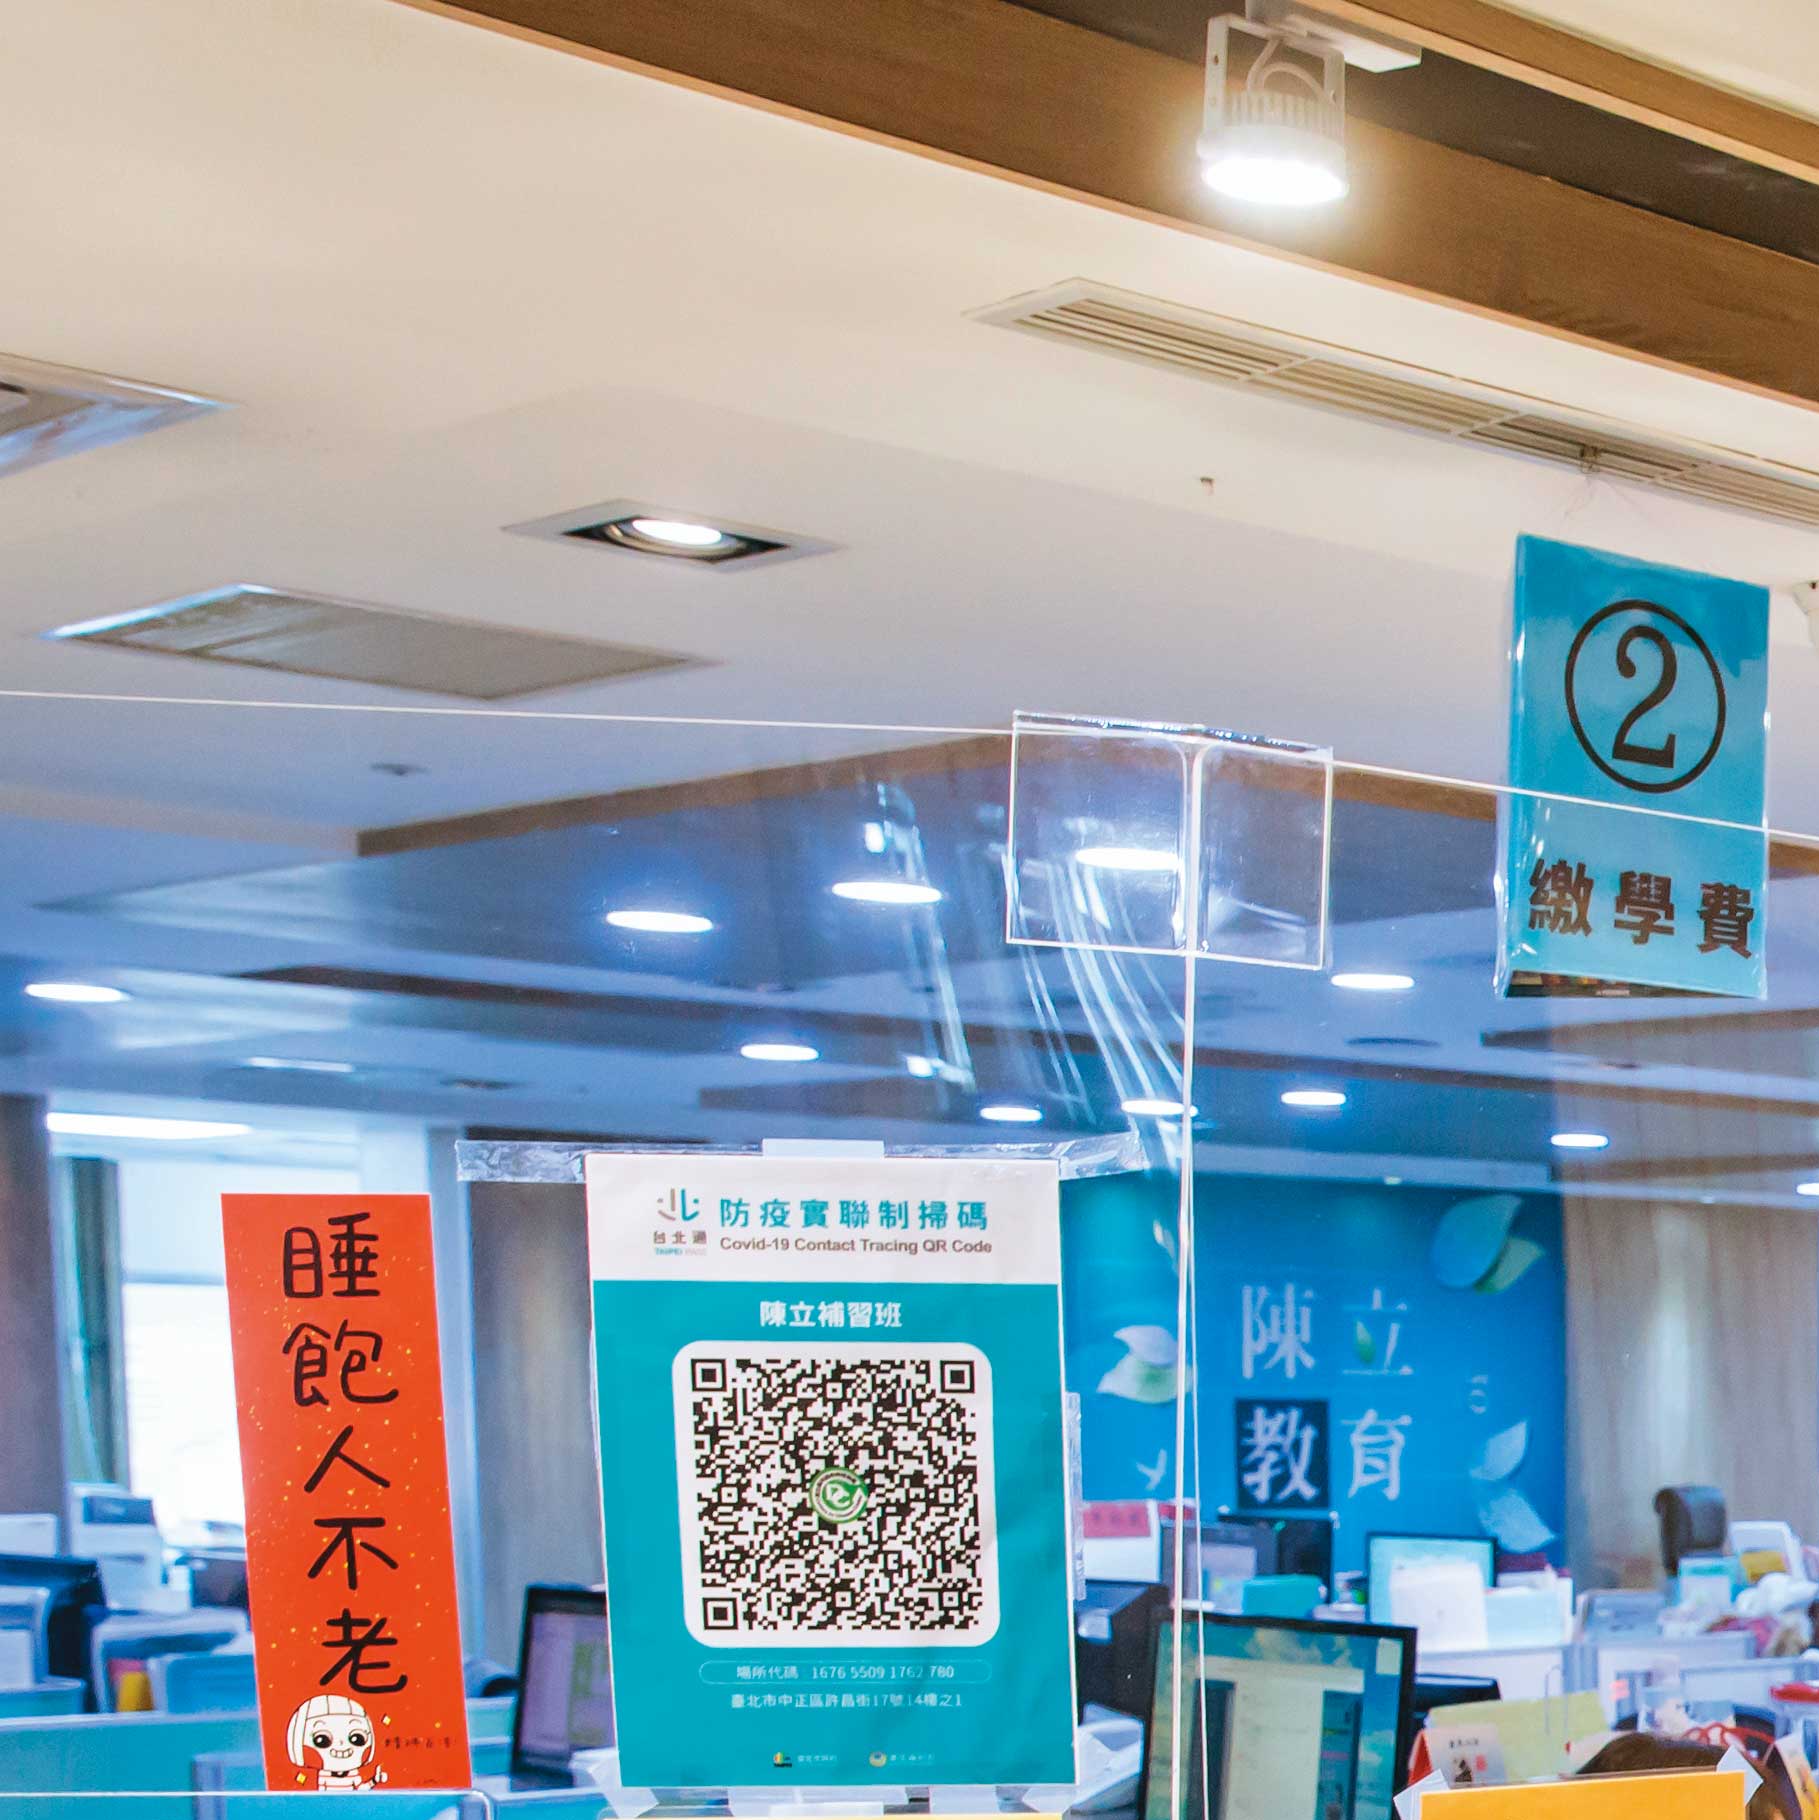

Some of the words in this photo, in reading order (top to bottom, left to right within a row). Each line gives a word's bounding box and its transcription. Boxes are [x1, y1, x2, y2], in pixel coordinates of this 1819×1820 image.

[1527, 858, 1755, 960] 繳學費
[719, 1197, 988, 1231] 防疫實聯制掃碼
[719, 1236, 790, 1252] Covid-19
[794, 1237, 856, 1252] Contact
[860, 1238, 919, 1255] Tracing
[923, 1239, 947, 1254] QR
[952, 1239, 992, 1254] Code
[759, 1300, 903, 1328] 陳立補習班
[1240, 1282, 1415, 1380] 陳立
[282, 1211, 408, 1695] 睡飽人不老
[1242, 1405, 1414, 1502] 教育
[811, 1666, 847, 1680] 1676
[850, 1666, 885, 1680] 5509
[929, 1666, 955, 1679] 780
